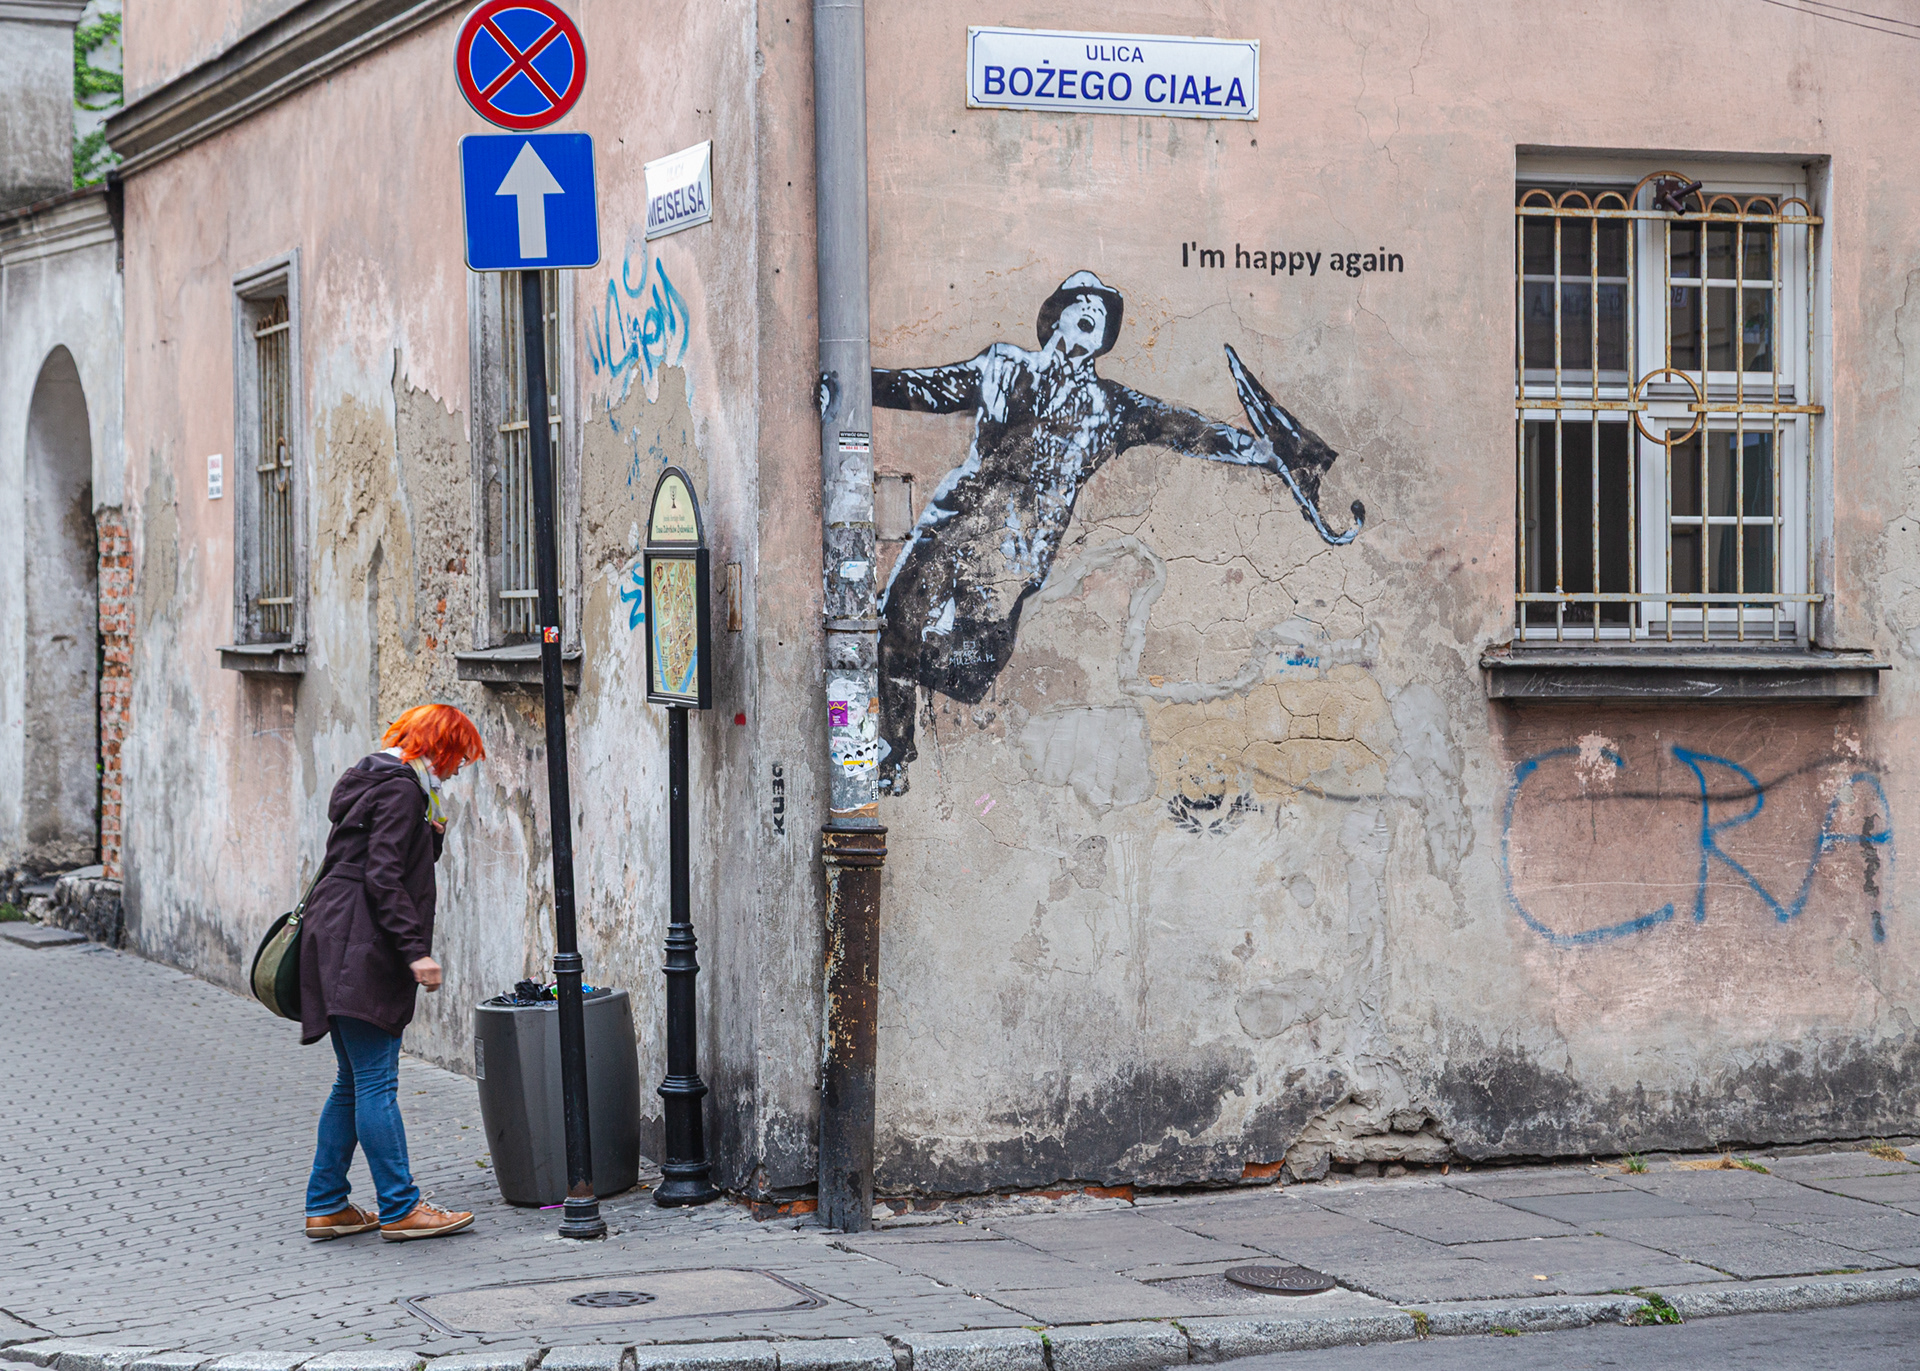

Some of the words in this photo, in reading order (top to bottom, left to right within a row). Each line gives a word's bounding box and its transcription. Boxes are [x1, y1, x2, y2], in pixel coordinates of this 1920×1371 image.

[1085, 45, 1145, 64] ULICA
[983, 60, 1133, 102] BOŻEGO
[1144, 73, 1248, 108] CIAŁA
[647, 180, 706, 228] MEISELSA
[1181, 241, 1226, 269] I'm
[1235, 242, 1321, 276] happy
[1330, 246, 1405, 278] again
